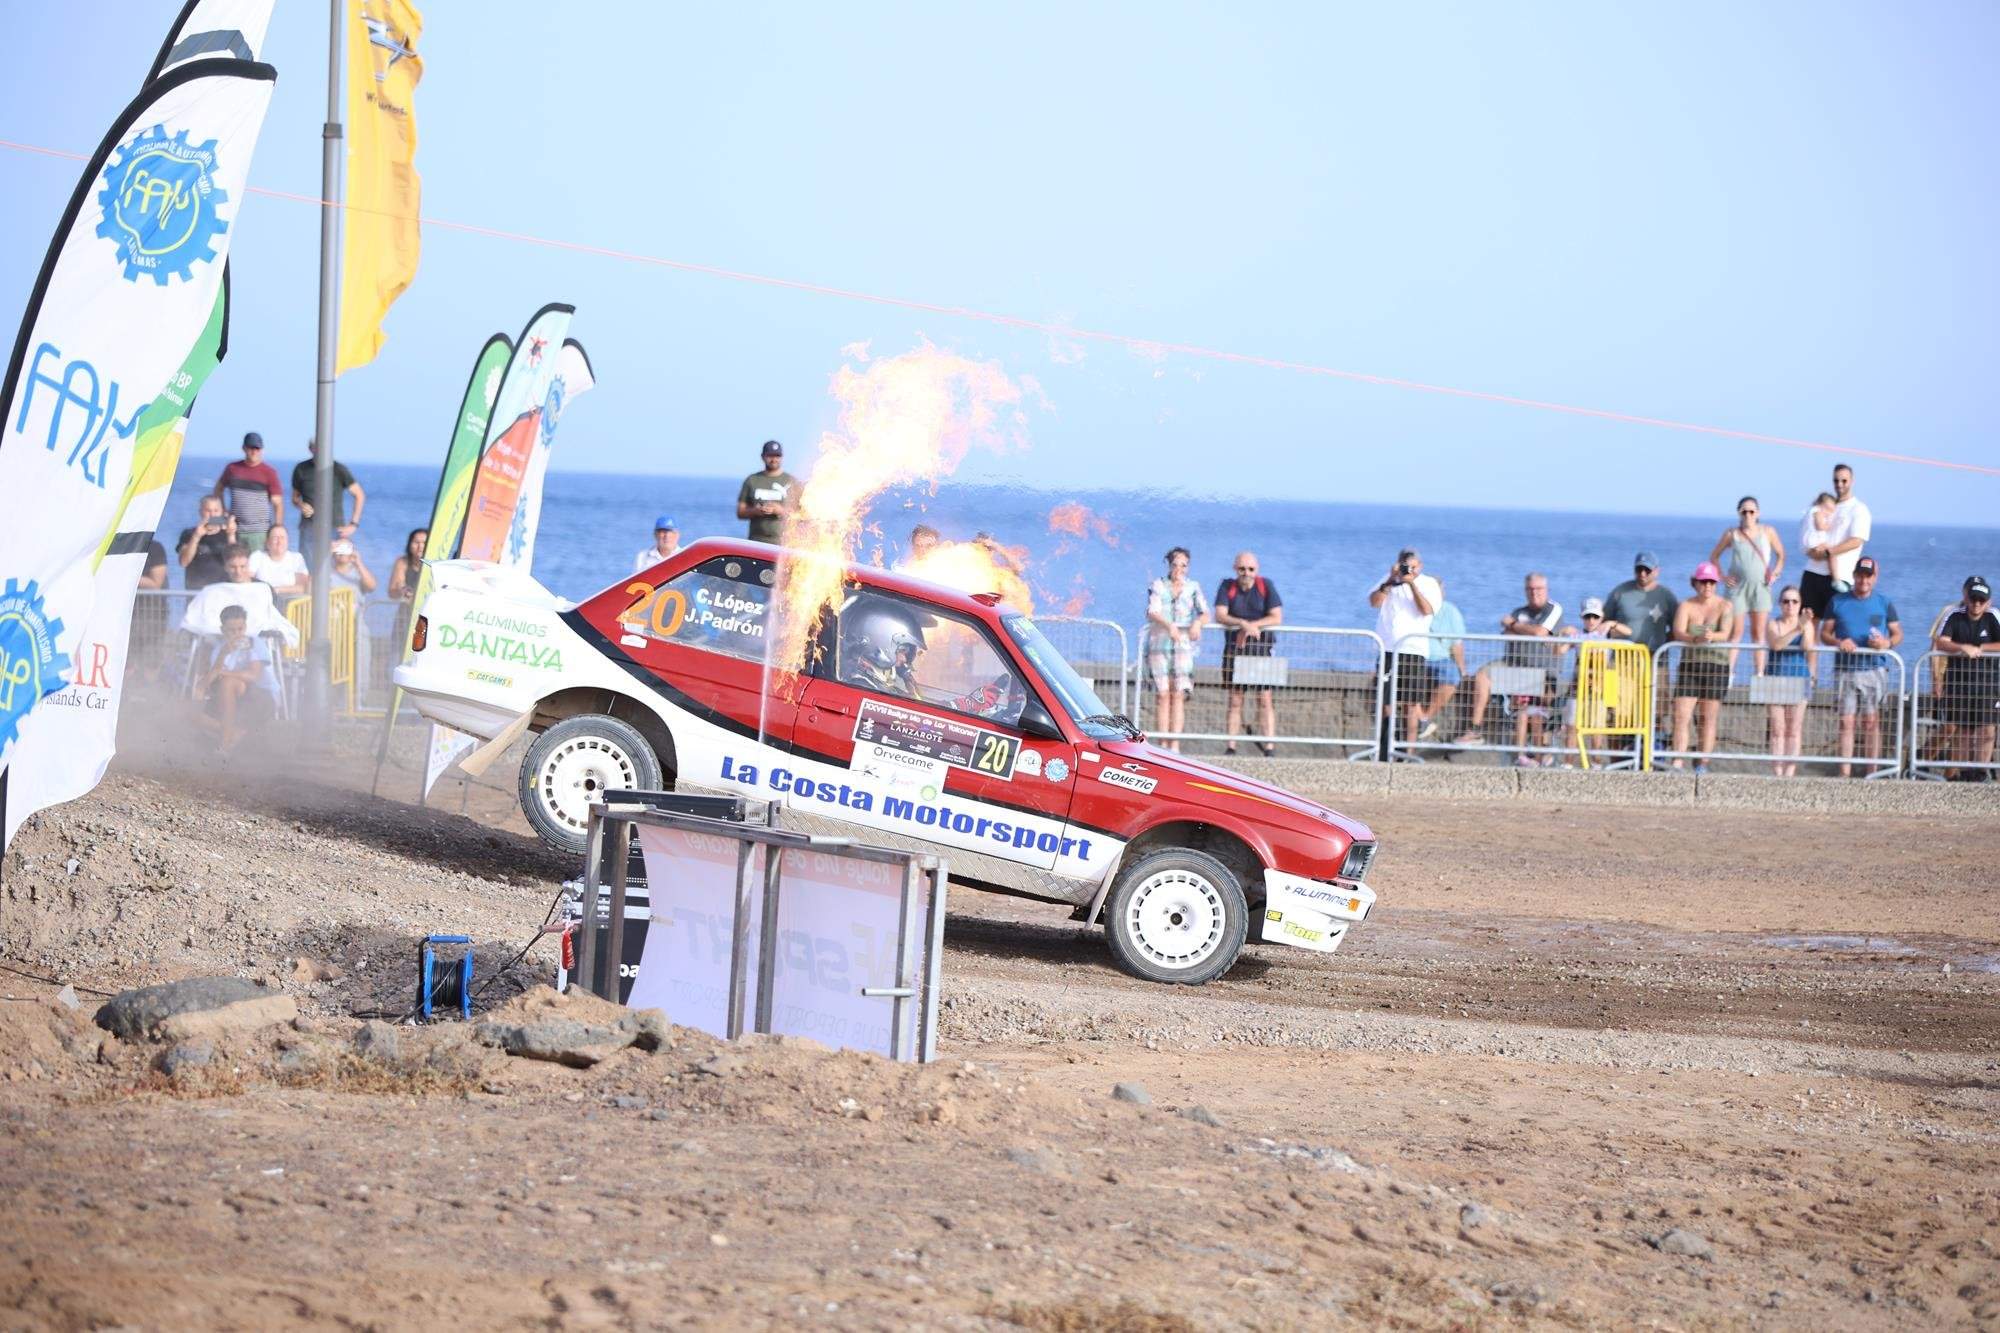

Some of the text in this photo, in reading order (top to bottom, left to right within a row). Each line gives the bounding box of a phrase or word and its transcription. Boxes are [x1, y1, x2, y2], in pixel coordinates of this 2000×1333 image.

[615, 582, 686, 636] 20
[464, 610, 548, 637] ALUMINIOS
[438, 624, 563, 672] DANTAYA
[86, 691, 109, 710] Car
[890, 724, 943, 743] LANZAROTE
[923, 718, 932, 726] de
[873, 747, 934, 770] Orvecame
[978, 736, 1009, 773] 20
[721, 756, 1093, 861] La Costa Motorsport
